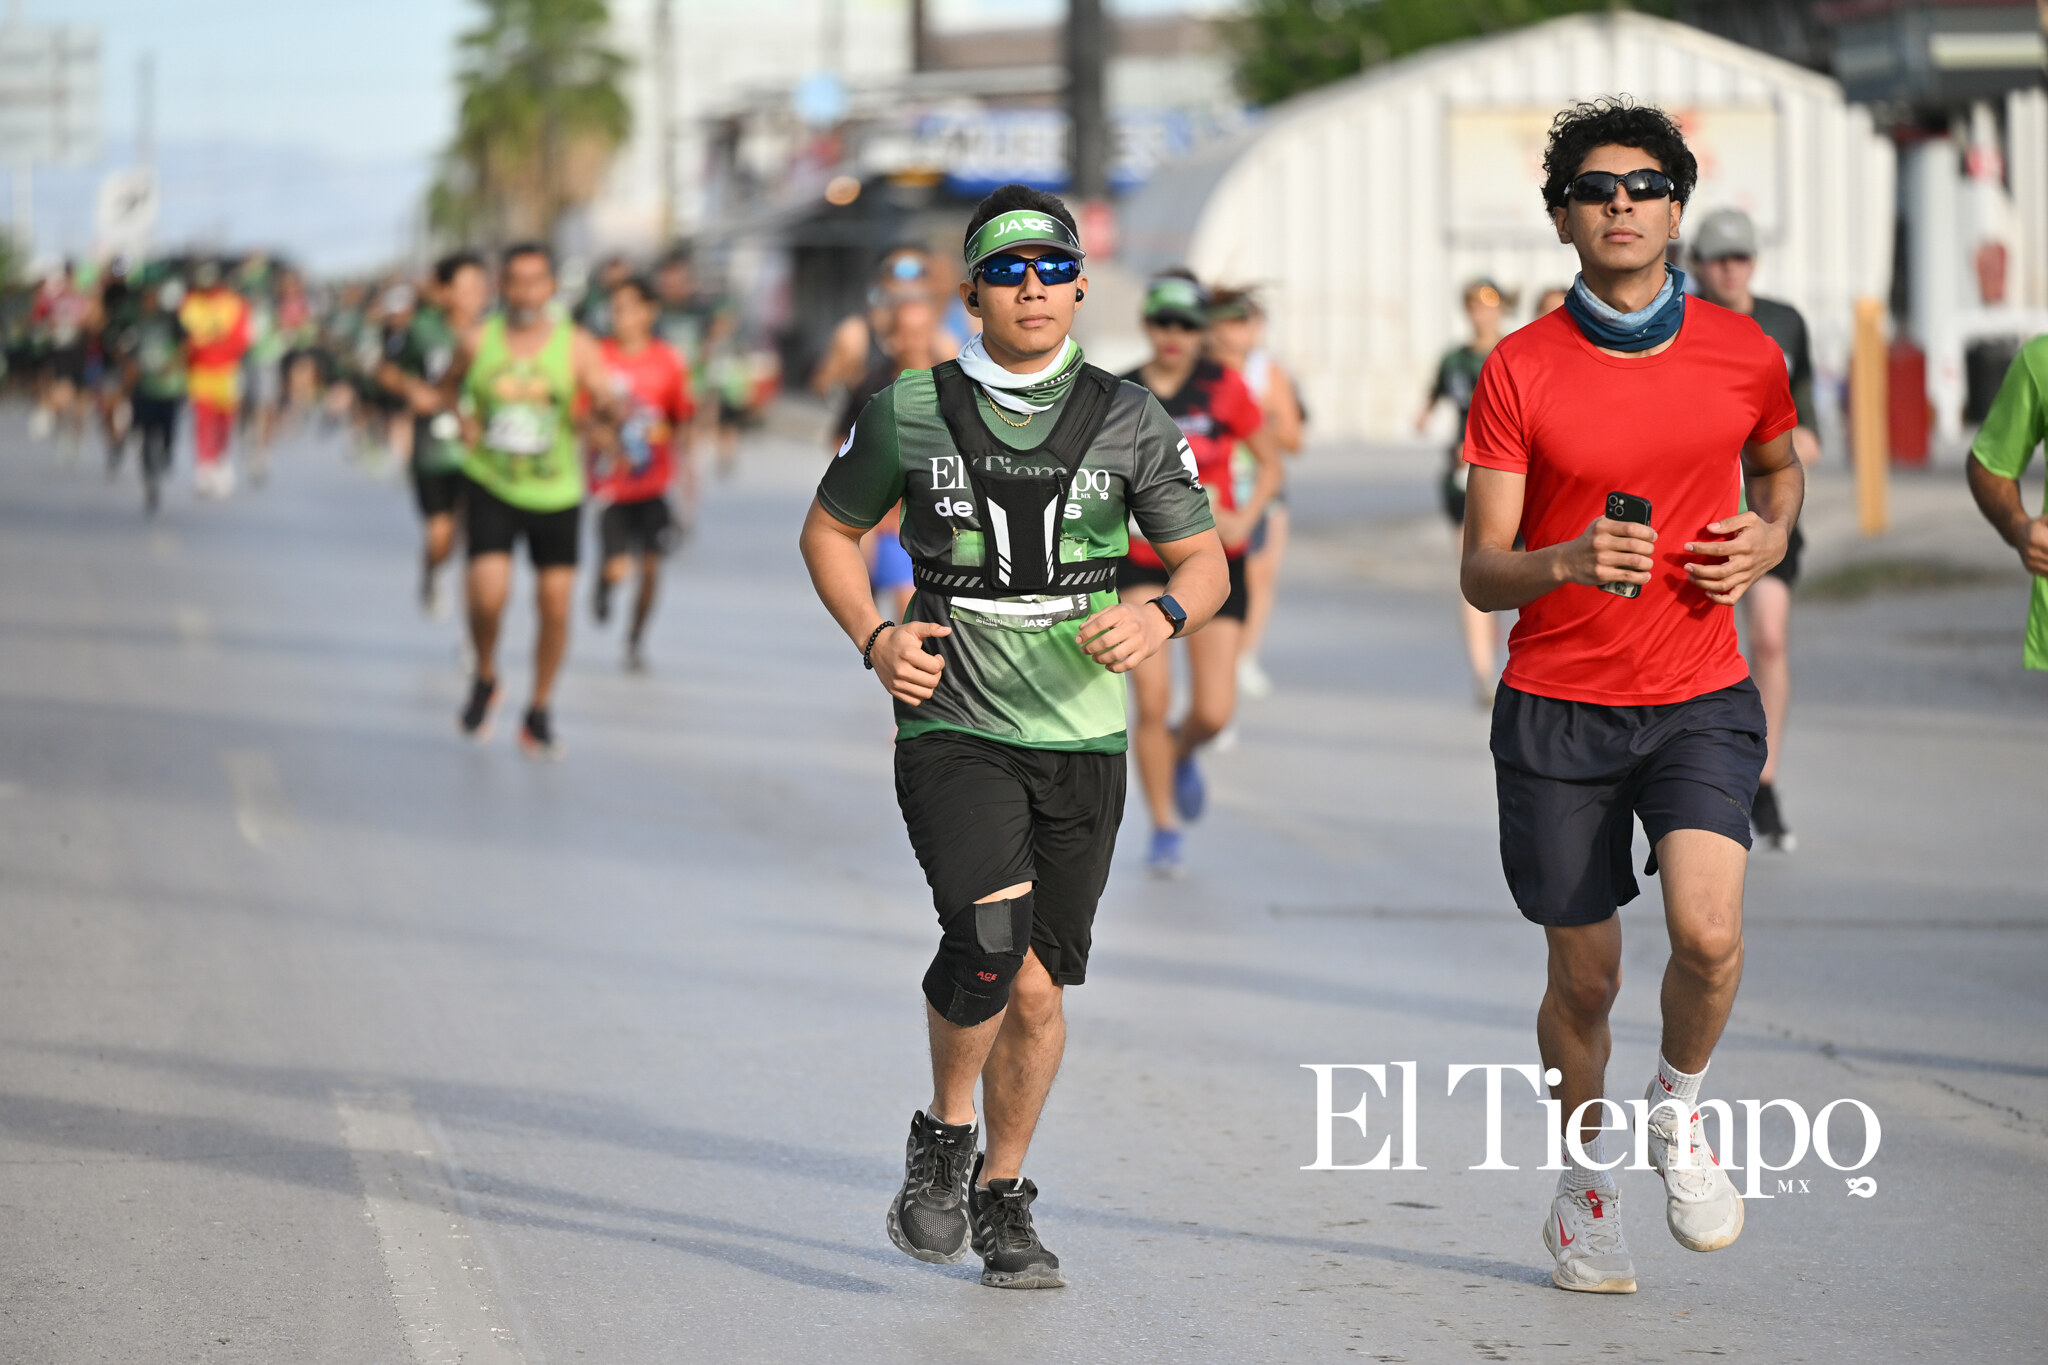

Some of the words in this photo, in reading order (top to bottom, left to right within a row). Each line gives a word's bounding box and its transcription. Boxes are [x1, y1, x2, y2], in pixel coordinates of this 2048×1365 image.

[928, 455, 968, 490] El
[934, 496, 974, 518] de
[976, 970, 998, 981] ACE
